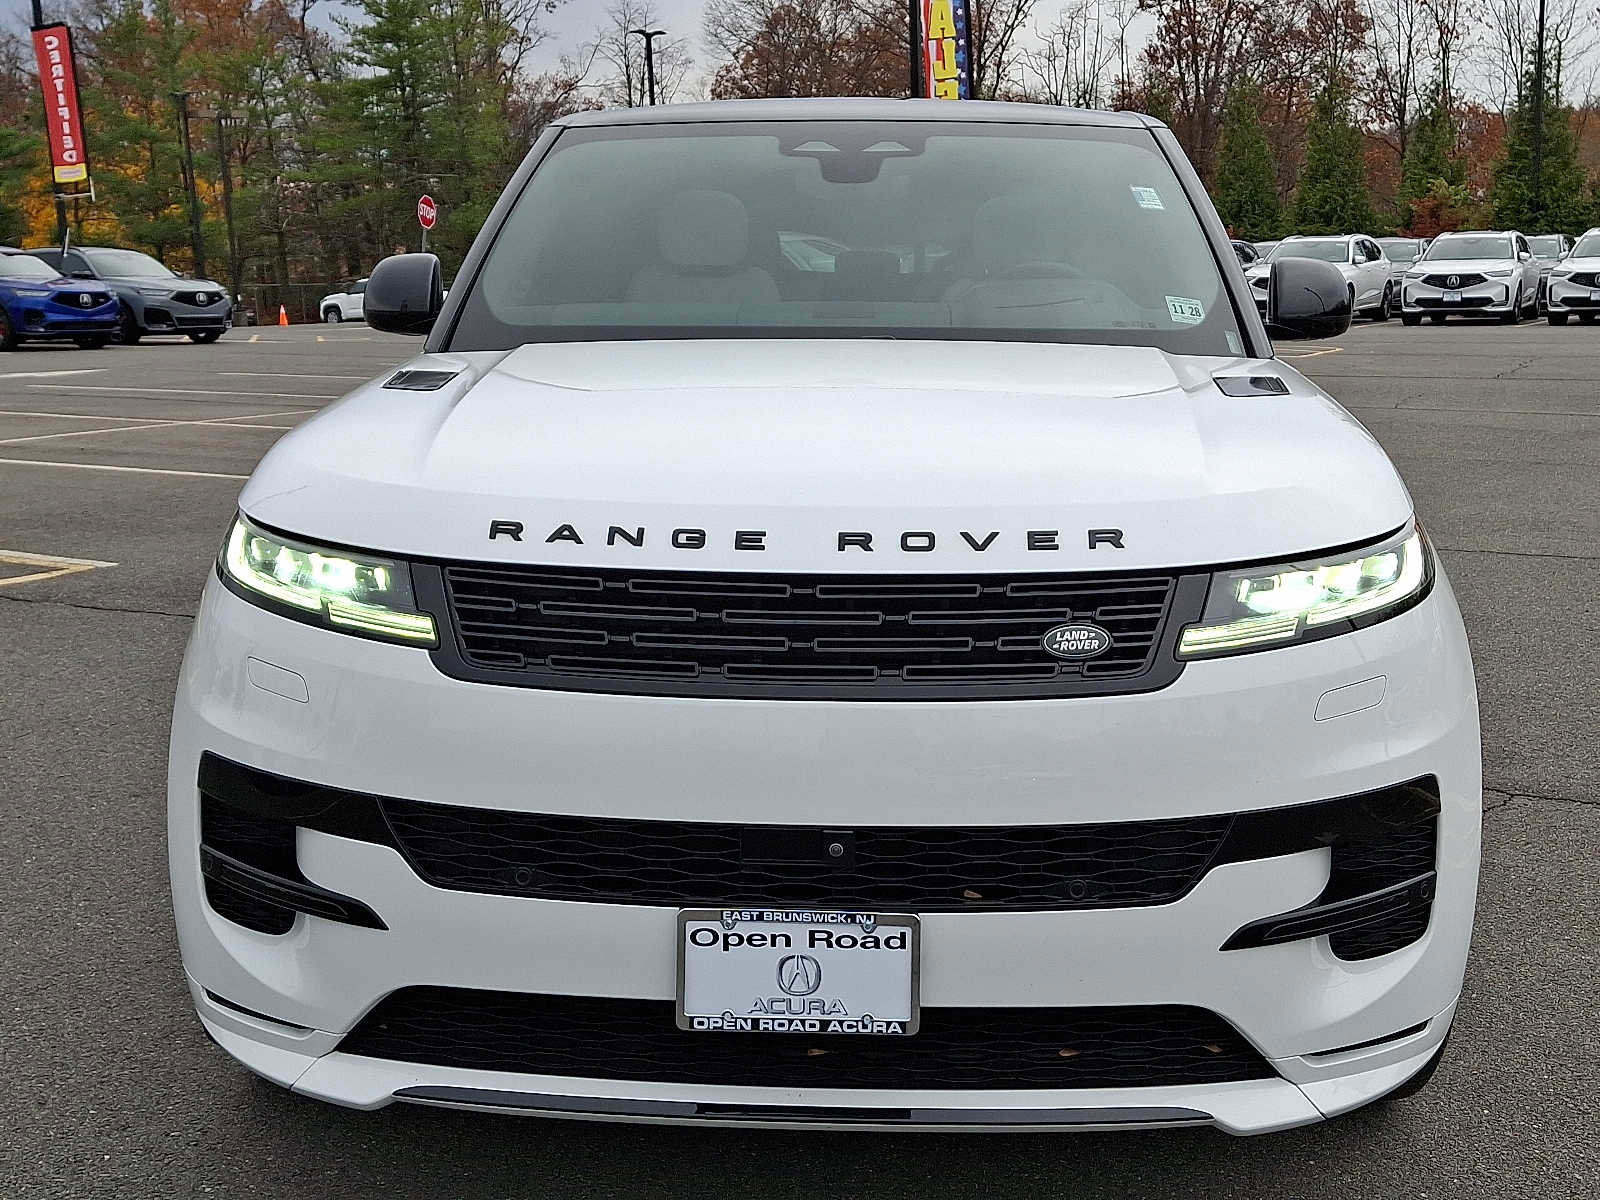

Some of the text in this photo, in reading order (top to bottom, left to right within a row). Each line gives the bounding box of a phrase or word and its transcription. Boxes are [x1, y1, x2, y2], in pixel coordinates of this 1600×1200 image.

[420, 203, 434, 219] STOP
[1171, 304, 1185, 315] 11
[1188, 306, 1202, 318] 28
[488, 520, 1125, 552] RANGE ROVER
[1056, 630, 1089, 641] LAND
[1060, 639, 1099, 651] ROVER
[722, 910, 760, 922] EAST
[855, 914, 876, 925] NJ
[689, 927, 907, 952] Open Road
[747, 997, 849, 1016] ACURA
[693, 1017, 903, 1034] OPEN ROAD ACURA
